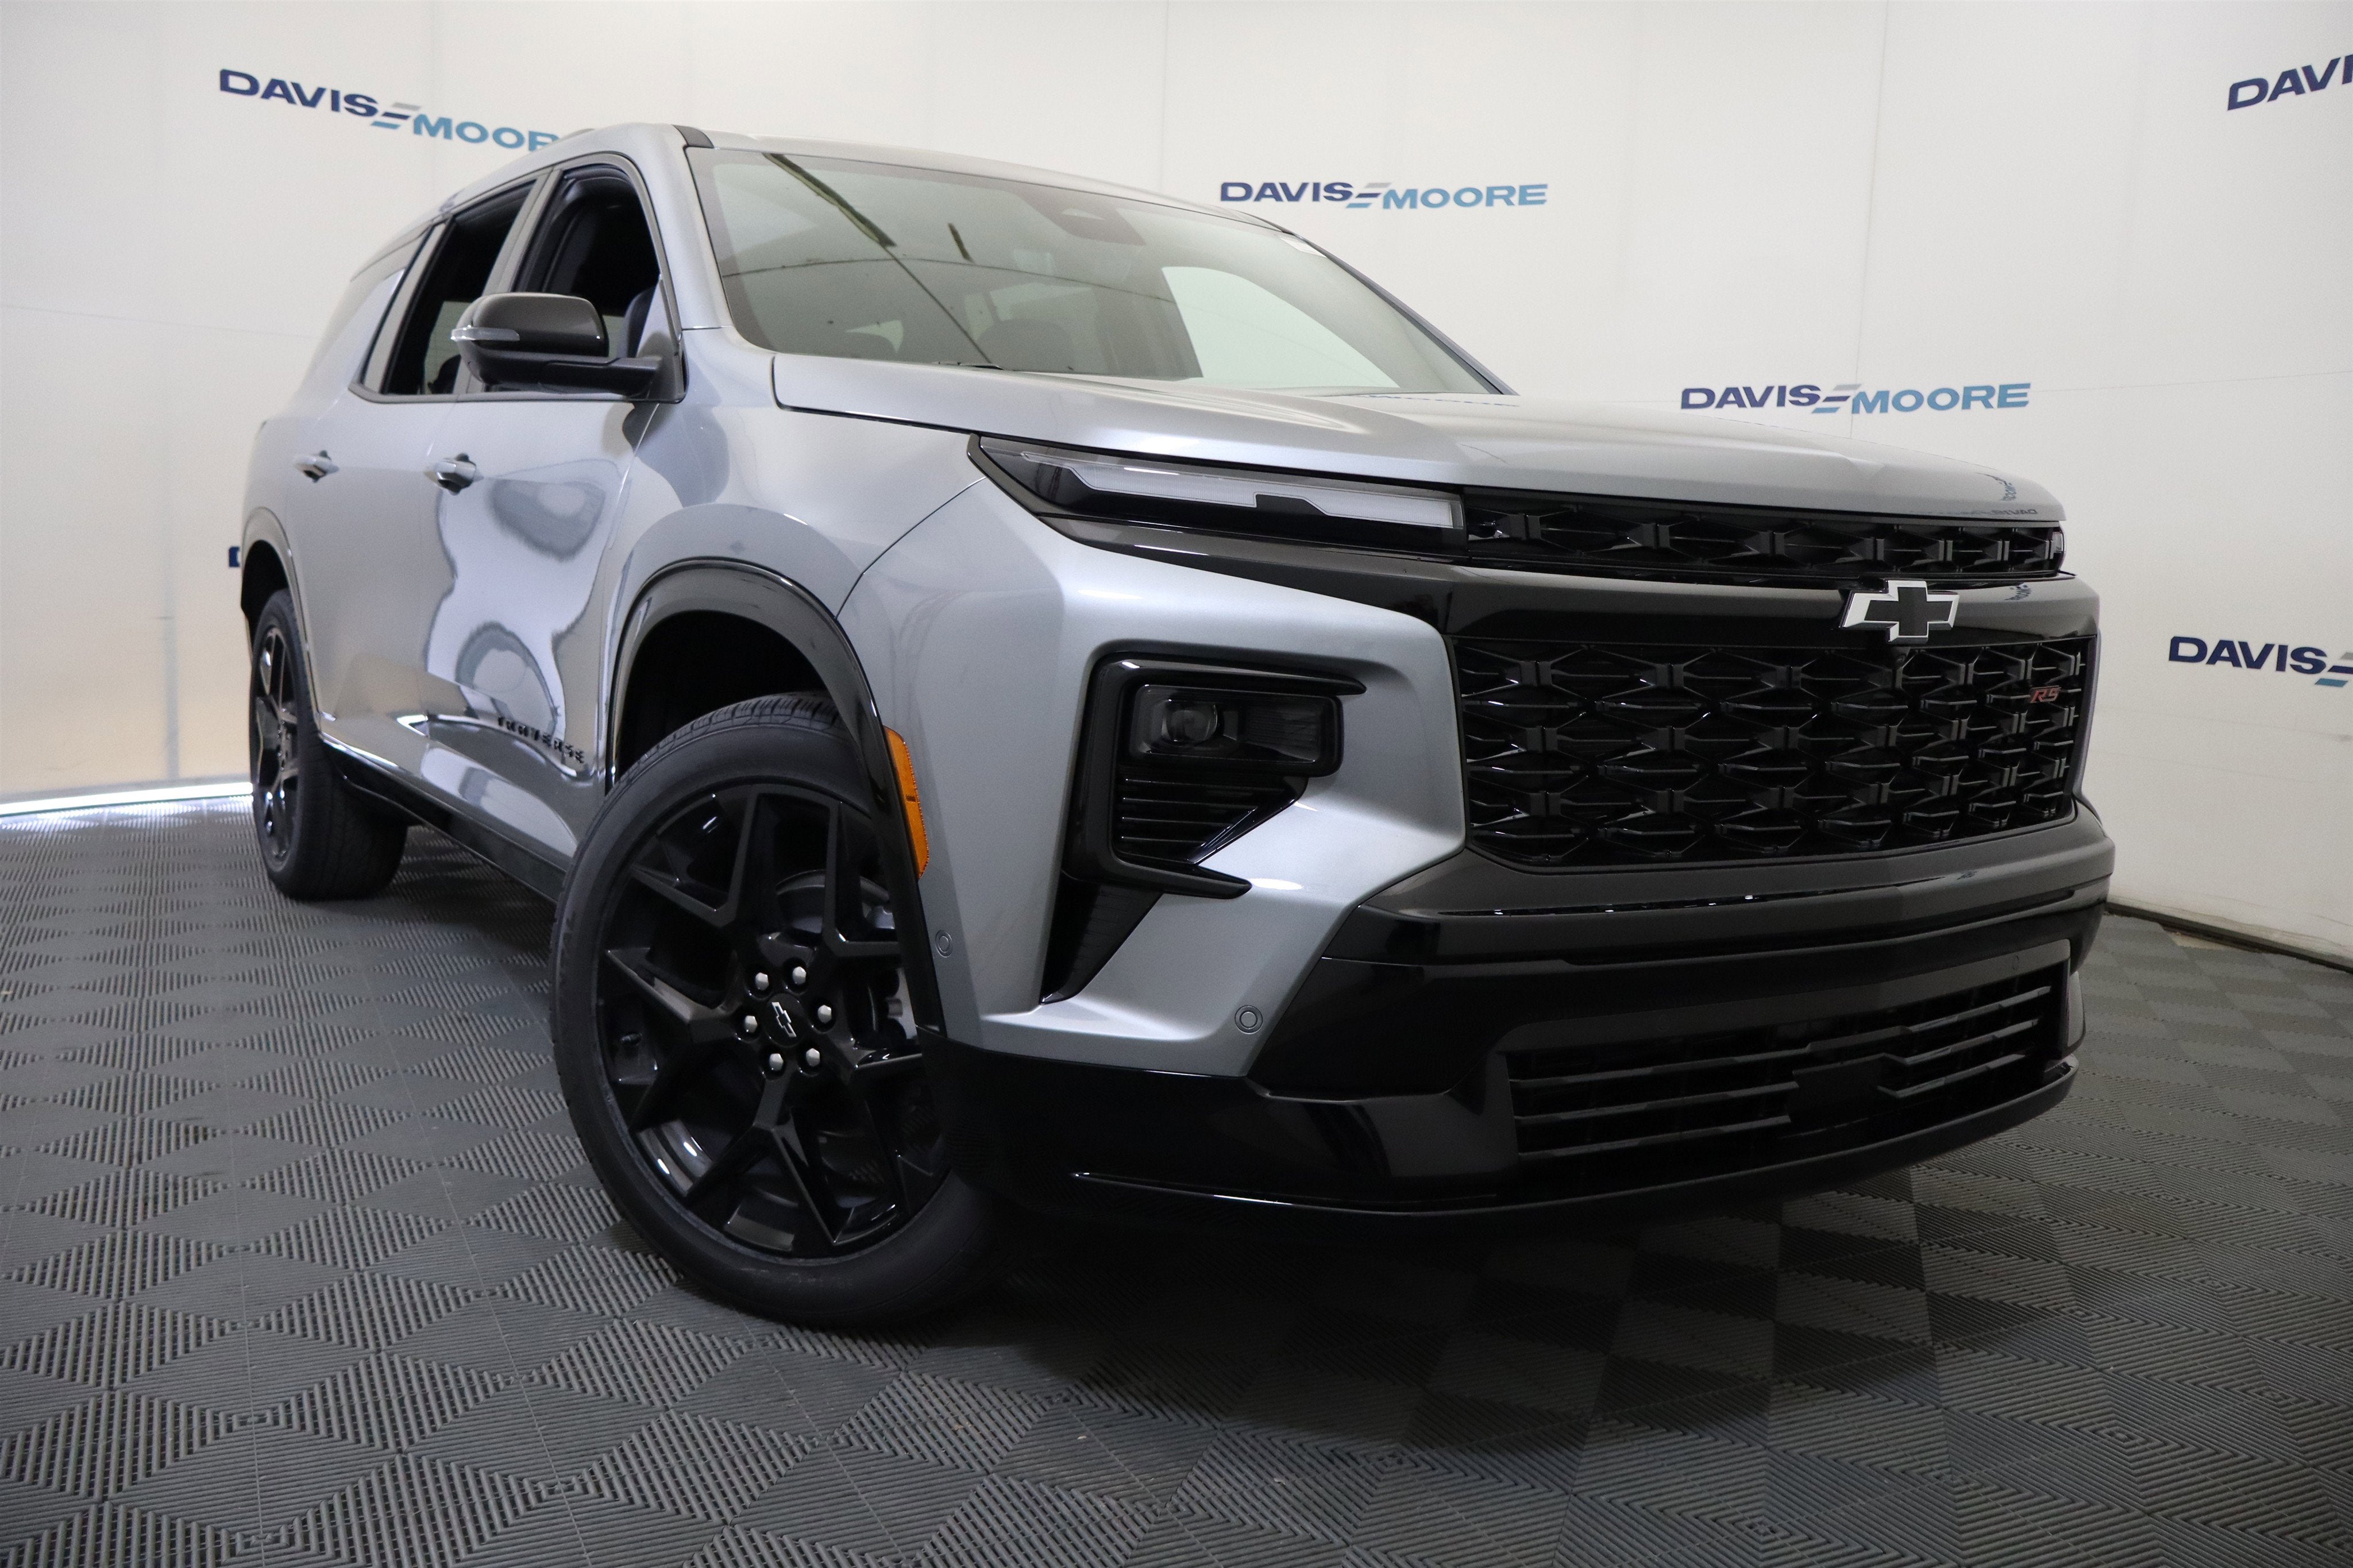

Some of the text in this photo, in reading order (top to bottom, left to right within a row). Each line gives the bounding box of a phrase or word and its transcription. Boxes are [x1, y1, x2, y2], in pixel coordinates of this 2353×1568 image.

[2227, 53, 2353, 111] DAVI
[219, 68, 560, 152] DAVIS MOOR
[1221, 181, 1548, 210] DAVIS MOORE
[1681, 383, 2032, 415] DAVIS MOORE
[2168, 635, 2328, 675] DAVIS
